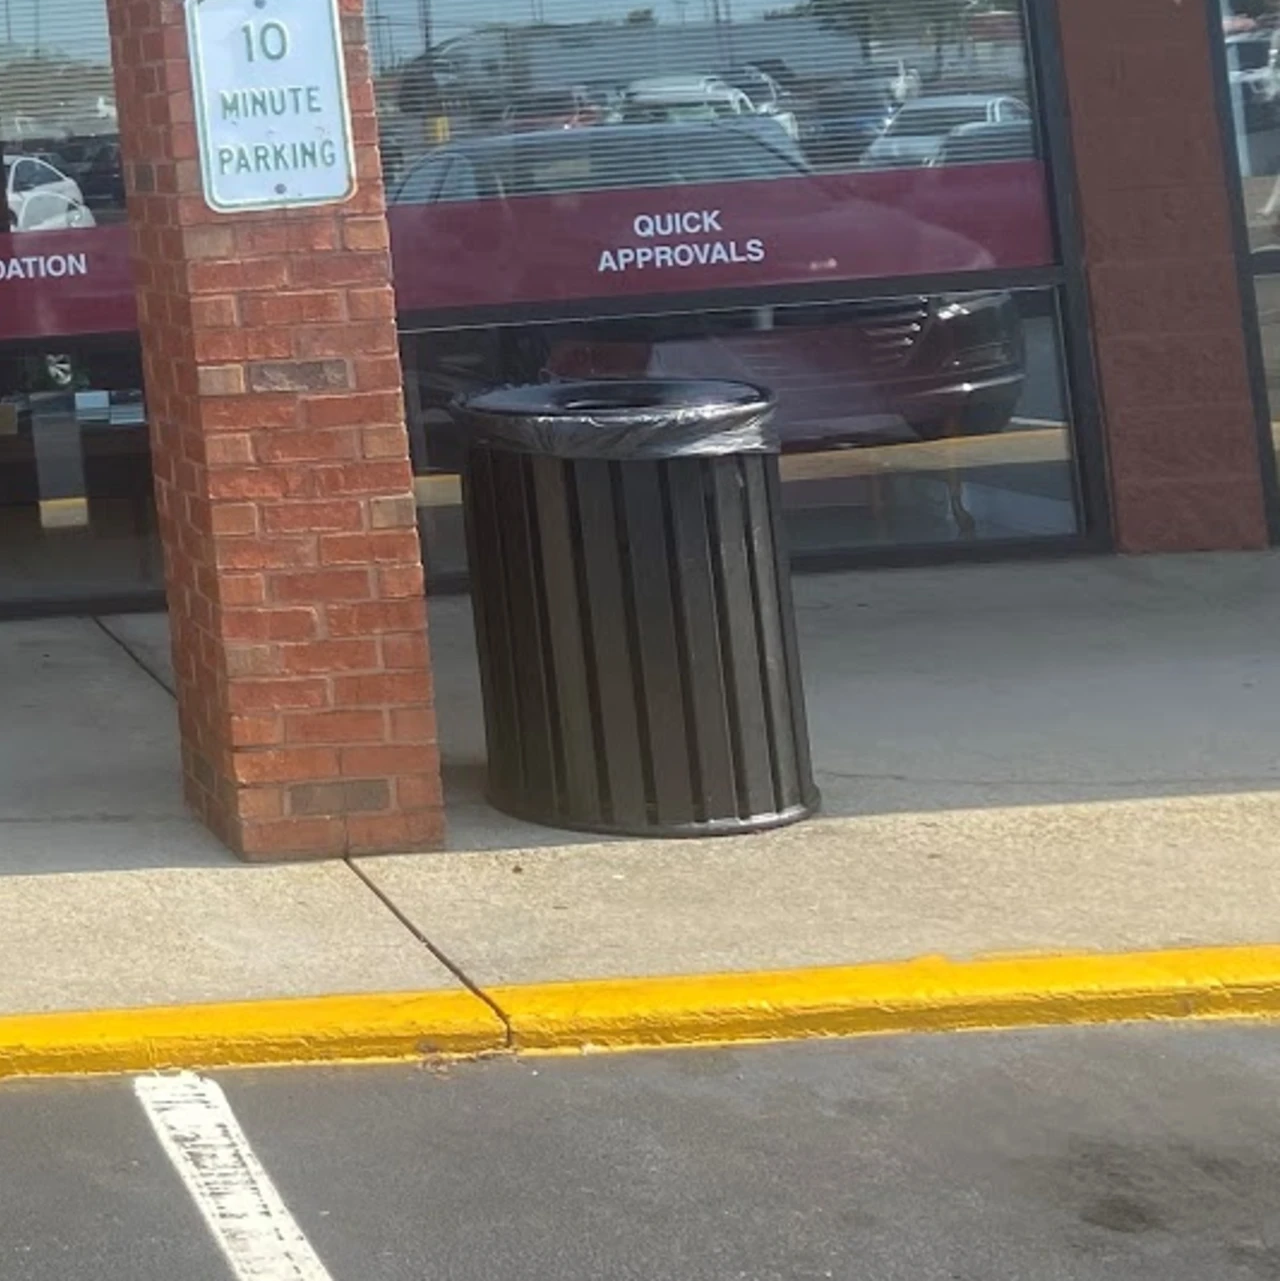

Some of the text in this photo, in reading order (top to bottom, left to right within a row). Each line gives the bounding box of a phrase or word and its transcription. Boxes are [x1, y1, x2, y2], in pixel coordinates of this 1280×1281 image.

[241, 21, 288, 63] 10
[220, 86, 323, 120] MINUTE
[218, 140, 336, 175] PARKING
[633, 209, 723, 237] QUICK
[598, 239, 765, 272] APPROVALS
